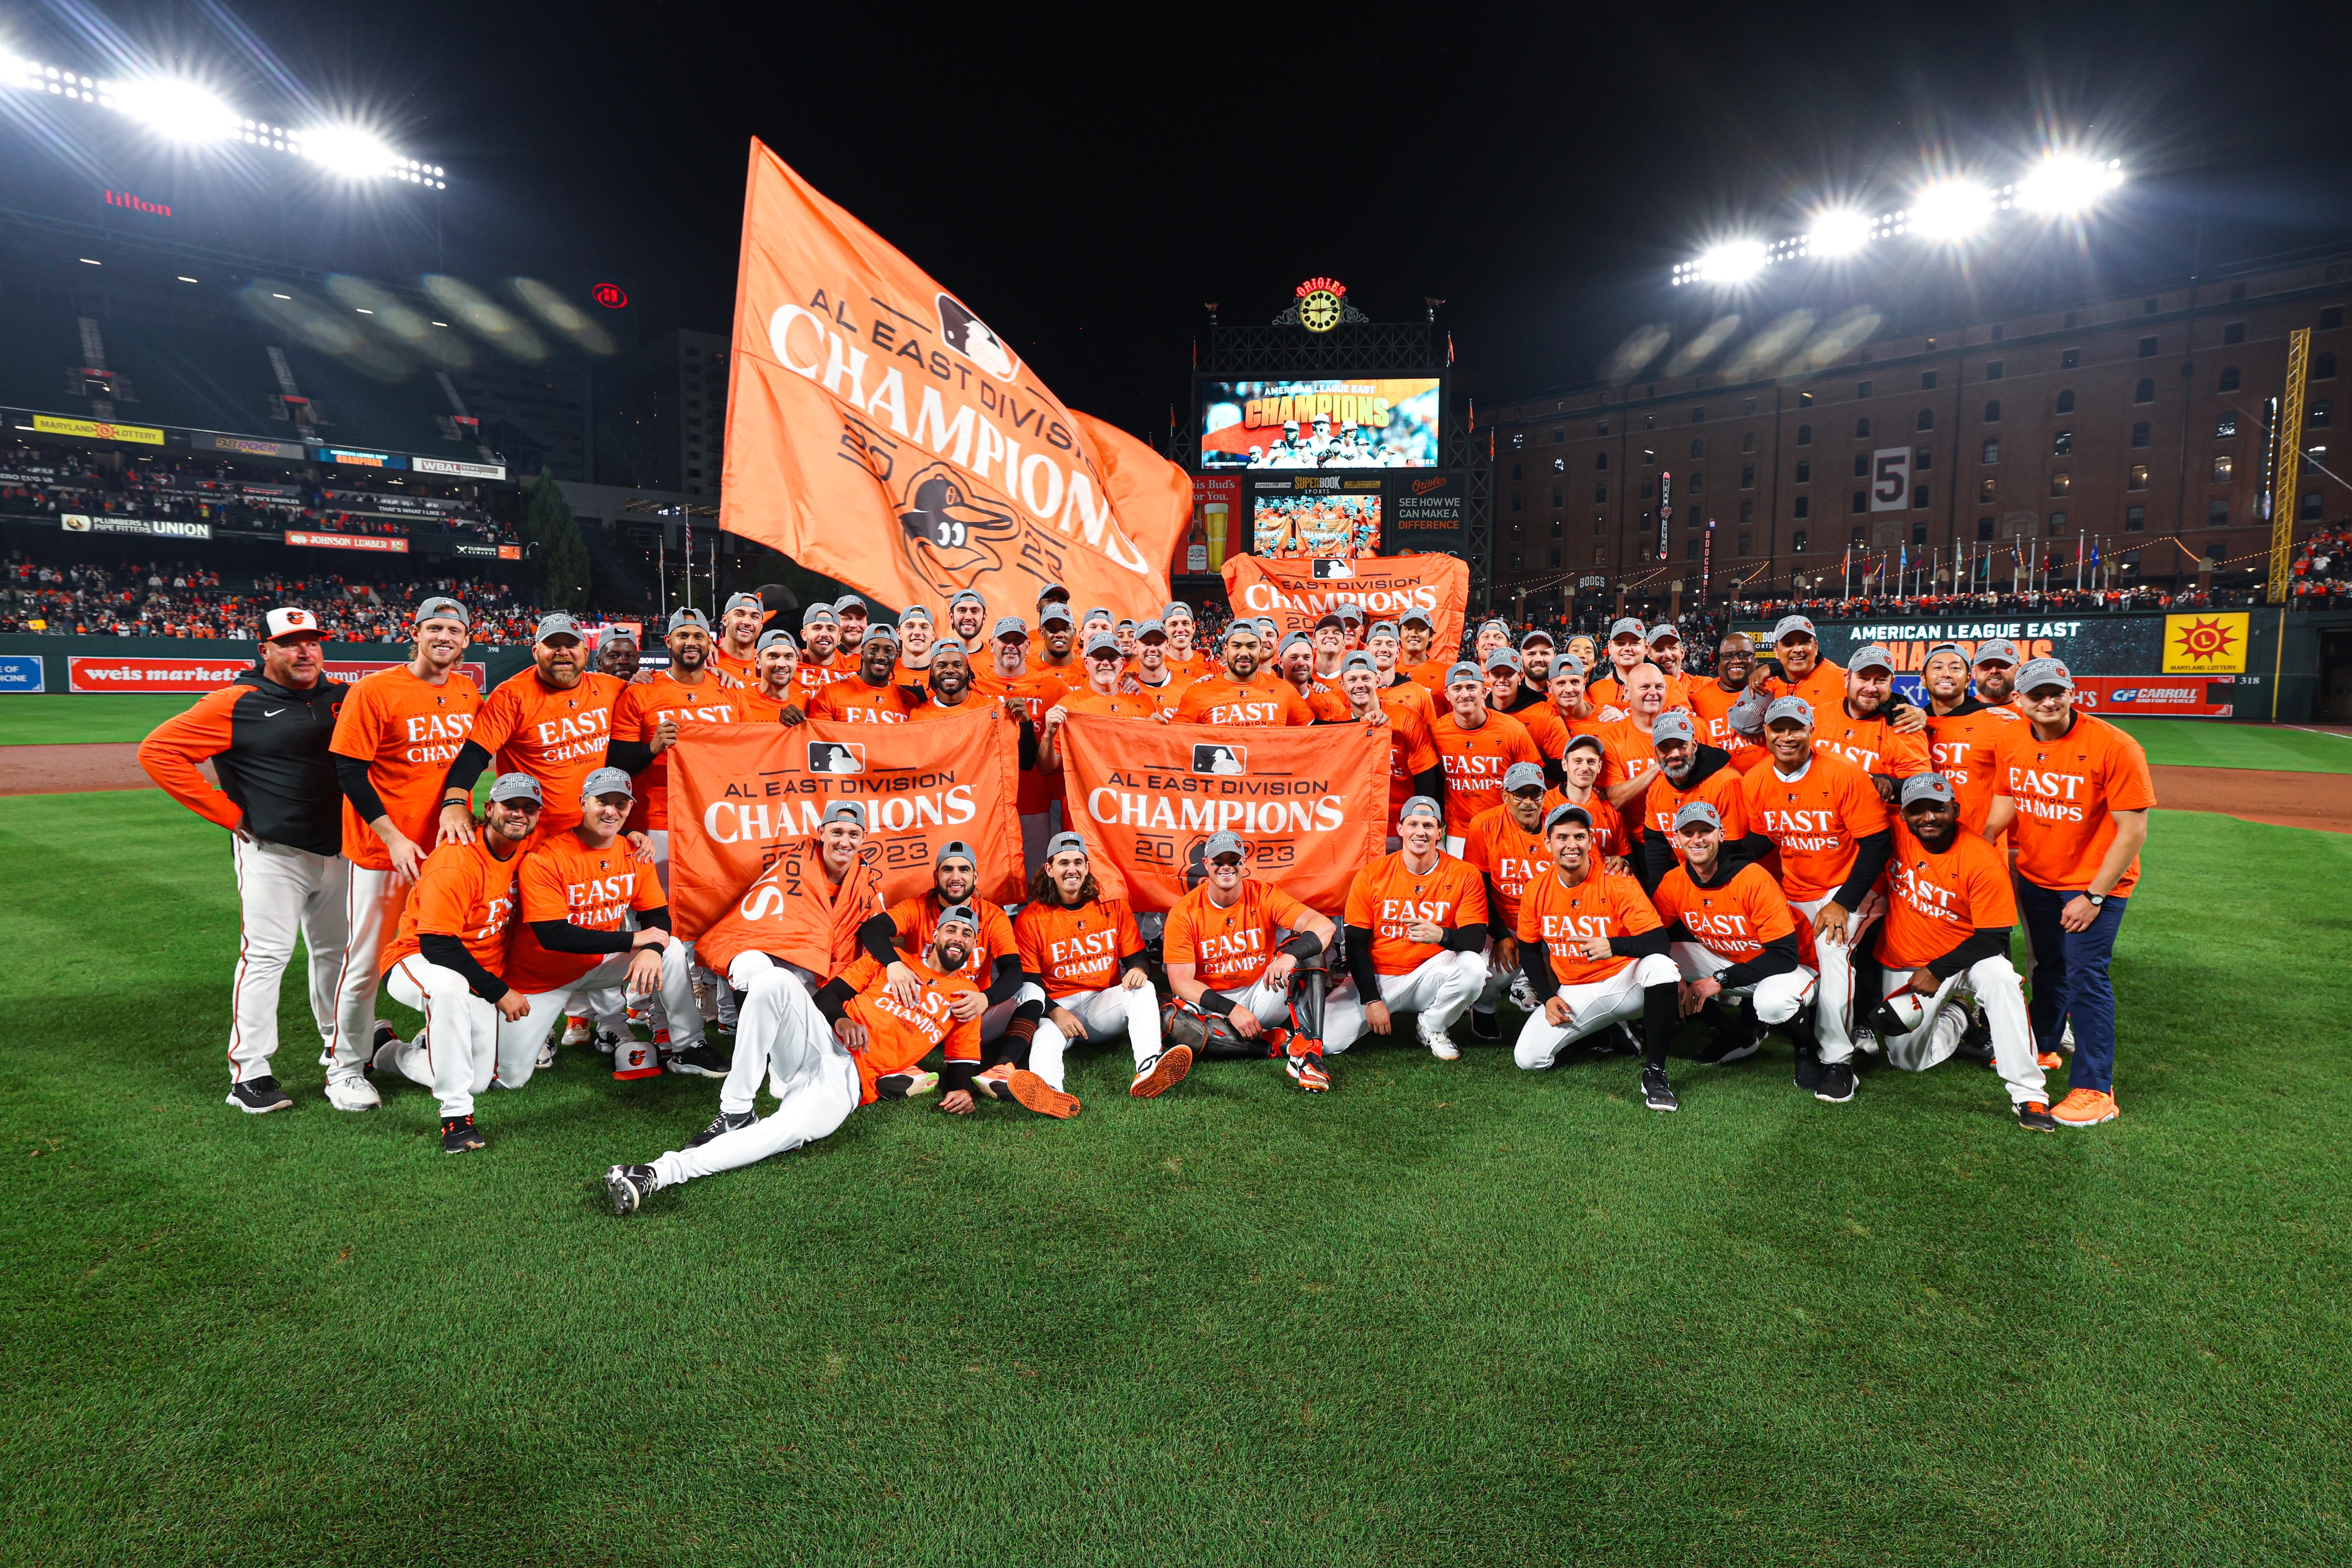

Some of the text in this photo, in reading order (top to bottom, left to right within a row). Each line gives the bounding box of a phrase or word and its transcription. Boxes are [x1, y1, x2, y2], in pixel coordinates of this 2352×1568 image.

[1296, 277, 1347, 297] ORIOLES
[810, 289, 972, 390] AL EAST
[1264, 384, 1375, 396] AMERICAN LEAGUE EAST
[1245, 396, 1390, 428] CHAMPIONS
[41, 420, 157, 440] MARYLAND LOTTERY
[423, 461, 461, 473] WBAL
[1208, 479, 1235, 489] Bud's
[1294, 476, 1341, 490] SUPERBOOK
[1412, 475, 1447, 495] Orioles
[1875, 455, 1906, 502] 5
[1206, 491, 1228, 501] You.
[1399, 498, 1460, 506] SEE HOW WE
[378, 505, 401, 513] THAT'S
[1399, 509, 1459, 518] CAN MAKE A
[93, 517, 141, 526] PLUMBERS
[117, 525, 151, 533] FITTERS
[153, 521, 209, 536] UNION
[1398, 520, 1459, 529] DIFFERENCE
[311, 535, 351, 546] JOHNSON
[354, 539, 387, 549] LUMBER
[1283, 576, 1421, 590] EAST DIVISION
[1580, 576, 1605, 588] BOOG'S
[1850, 622, 2080, 640] AMERICAN LEAGUE EAST
[2201, 634, 2211, 645] L
[84, 667, 142, 680] weis
[2138, 689, 2198, 698] CARROLL
[847, 707, 908, 723] EAST
[1212, 703, 1279, 724] EAST
[406, 714, 473, 743] EAST
[537, 707, 609, 745] EAST
[559, 732, 602, 748] DIVISION
[1442, 755, 1503, 774] EAST
[724, 771, 955, 797] AL EAST DIVISION
[1108, 772, 1328, 795] AL EAST DIVISION
[2009, 766, 2084, 800] EAST
[1089, 787, 1344, 833] CHAMPIONS
[2014, 796, 2083, 822] CHAMPS
[1763, 810, 1833, 833] EAST
[887, 841, 929, 864] 23
[1135, 840, 1295, 862] 20 23
[568, 873, 635, 906] EAST
[1890, 861, 1956, 909] EAST
[583, 899, 624, 911] DIVISION
[1383, 900, 1450, 922] EAST
[1542, 916, 1611, 938] EAST
[1684, 911, 1748, 937] EAST
[1201, 928, 1262, 959] EAST
[1701, 931, 1741, 940] DIVISION
[1050, 928, 1116, 963] EAST
[1067, 952, 1108, 964] DIVISION
[1204, 954, 1266, 974] CHAMPS
[1216, 952, 1253, 963] DIVISION
[874, 997, 942, 1044] CHAMPS
